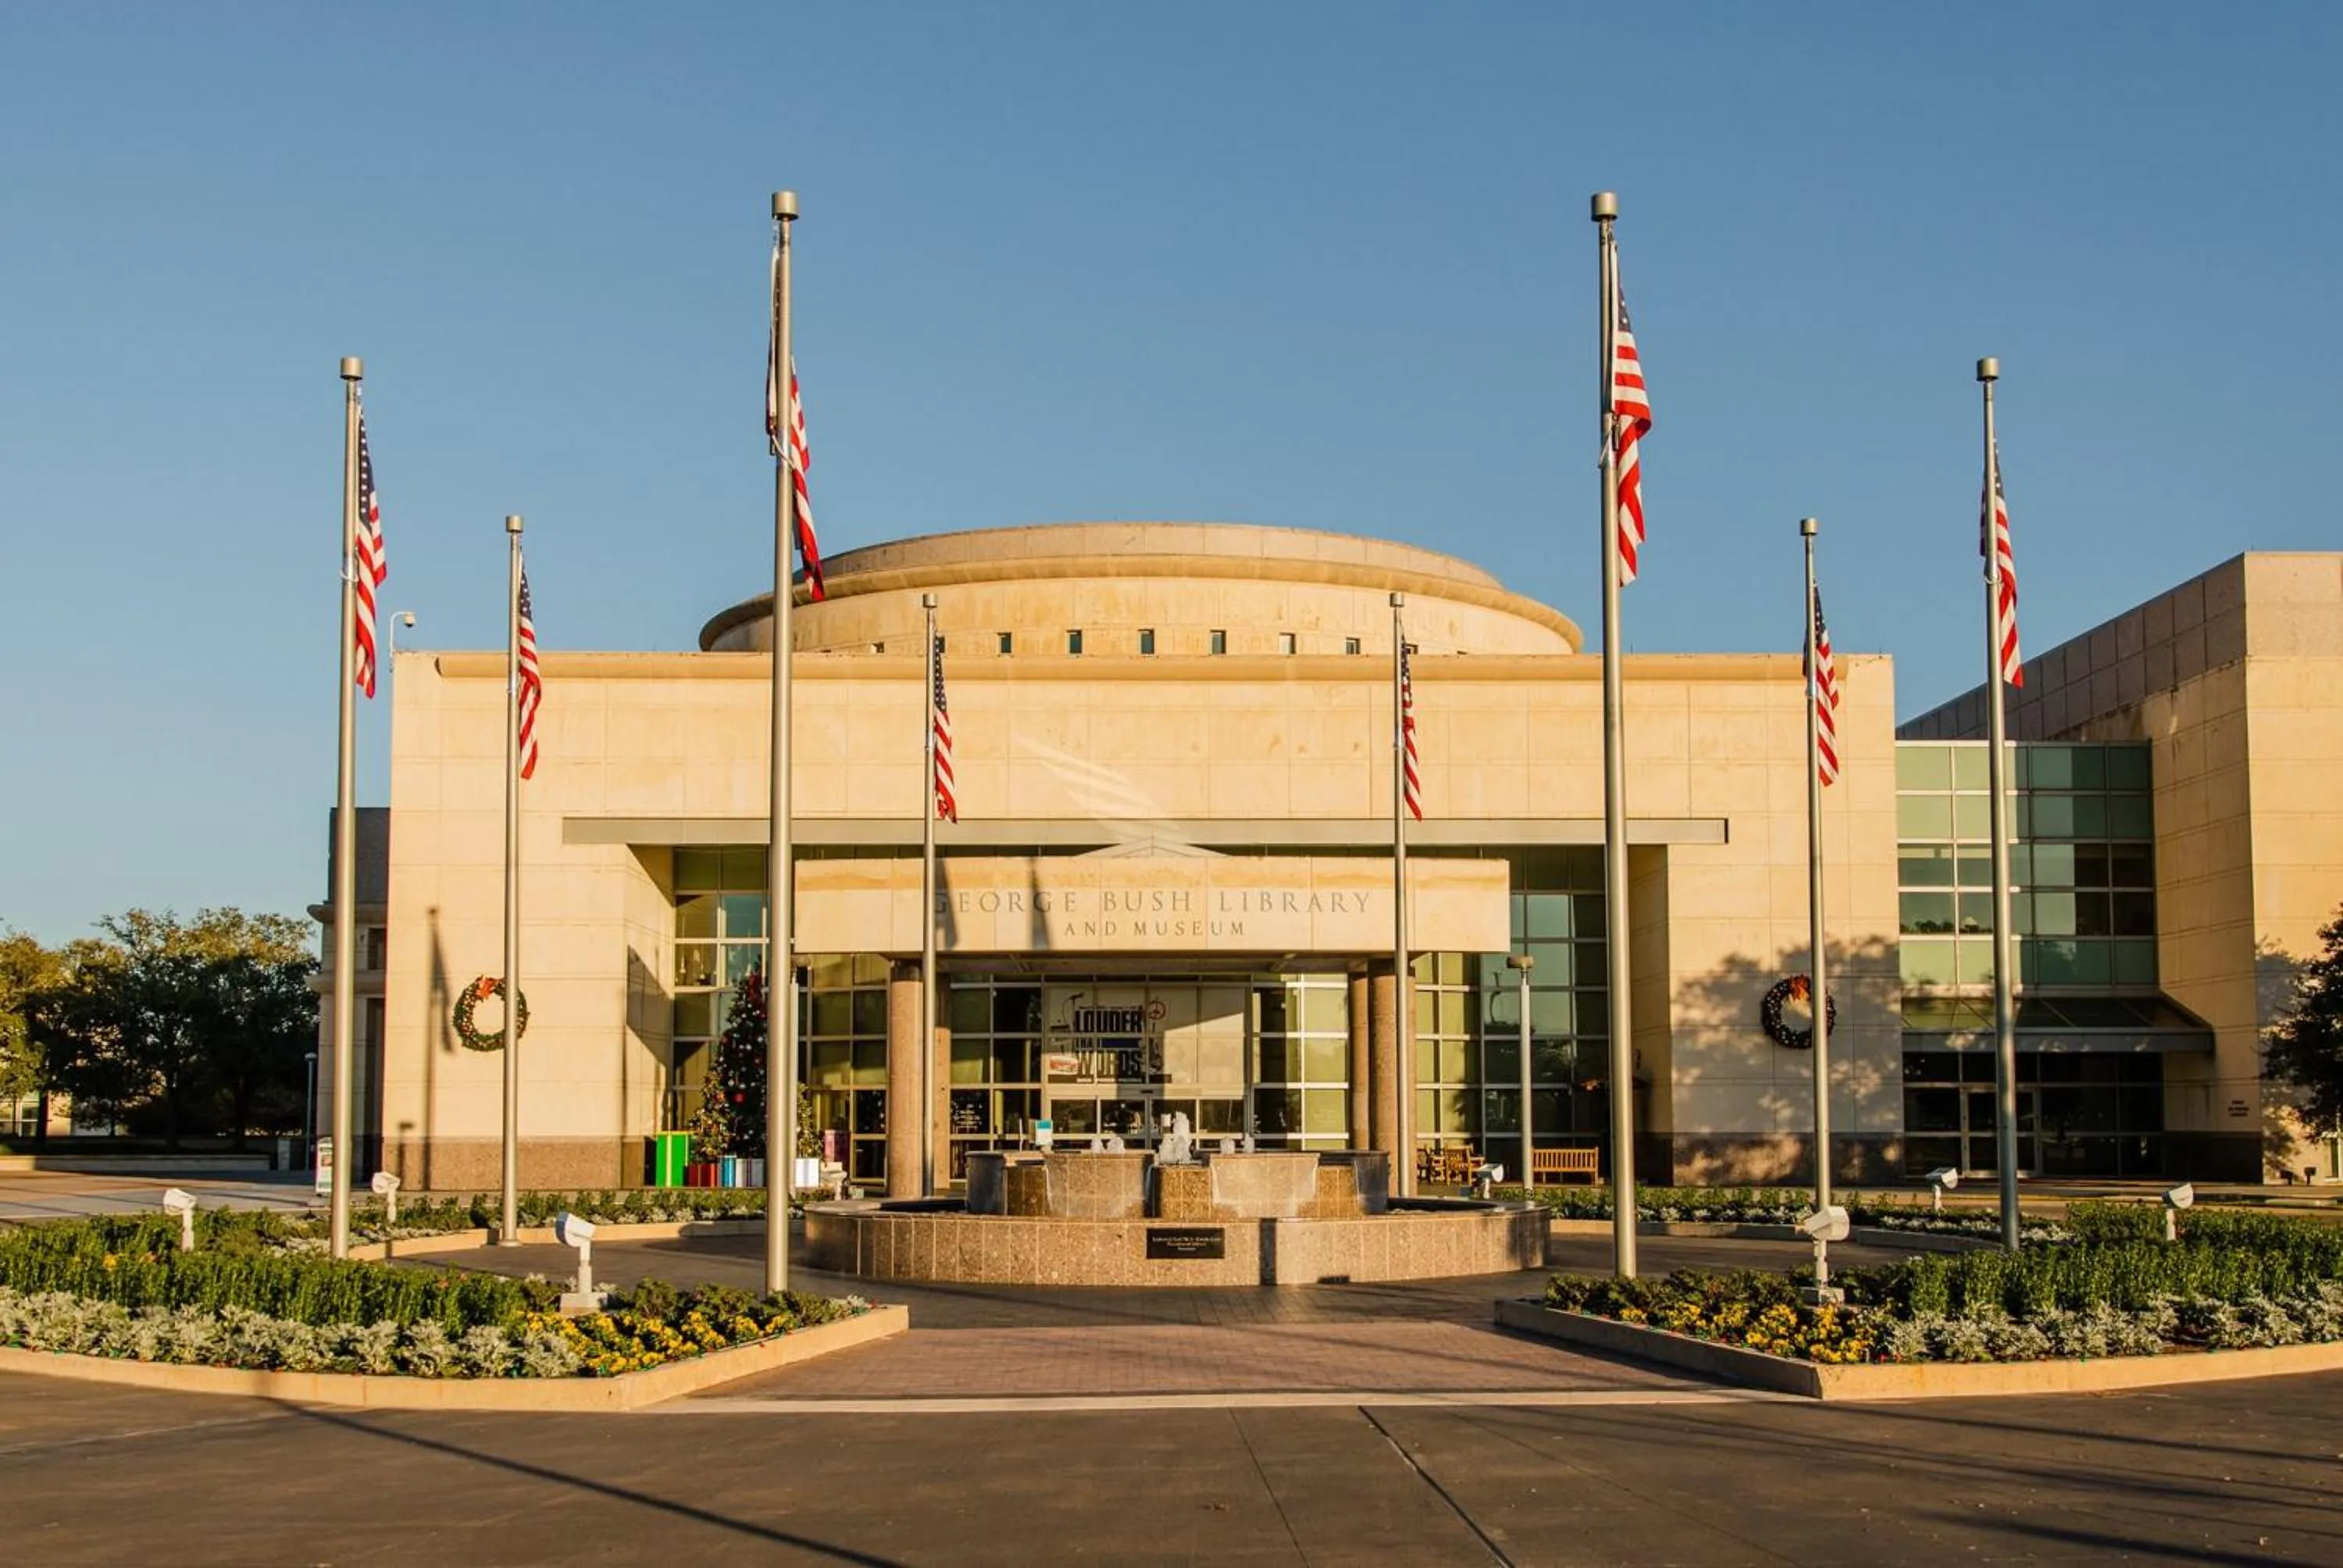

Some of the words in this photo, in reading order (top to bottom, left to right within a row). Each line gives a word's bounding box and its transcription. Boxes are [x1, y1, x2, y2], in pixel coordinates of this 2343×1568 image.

[935, 891, 1077, 913] GEORGE
[1103, 891, 1192, 912] BUSH
[1219, 891, 1369, 913] LIBRARY
[1065, 921, 1117, 936] AND
[1133, 921, 1244, 936] MUSEUM
[1075, 1010, 1143, 1033] LOUDER
[1075, 1050, 1143, 1077] WORDS
